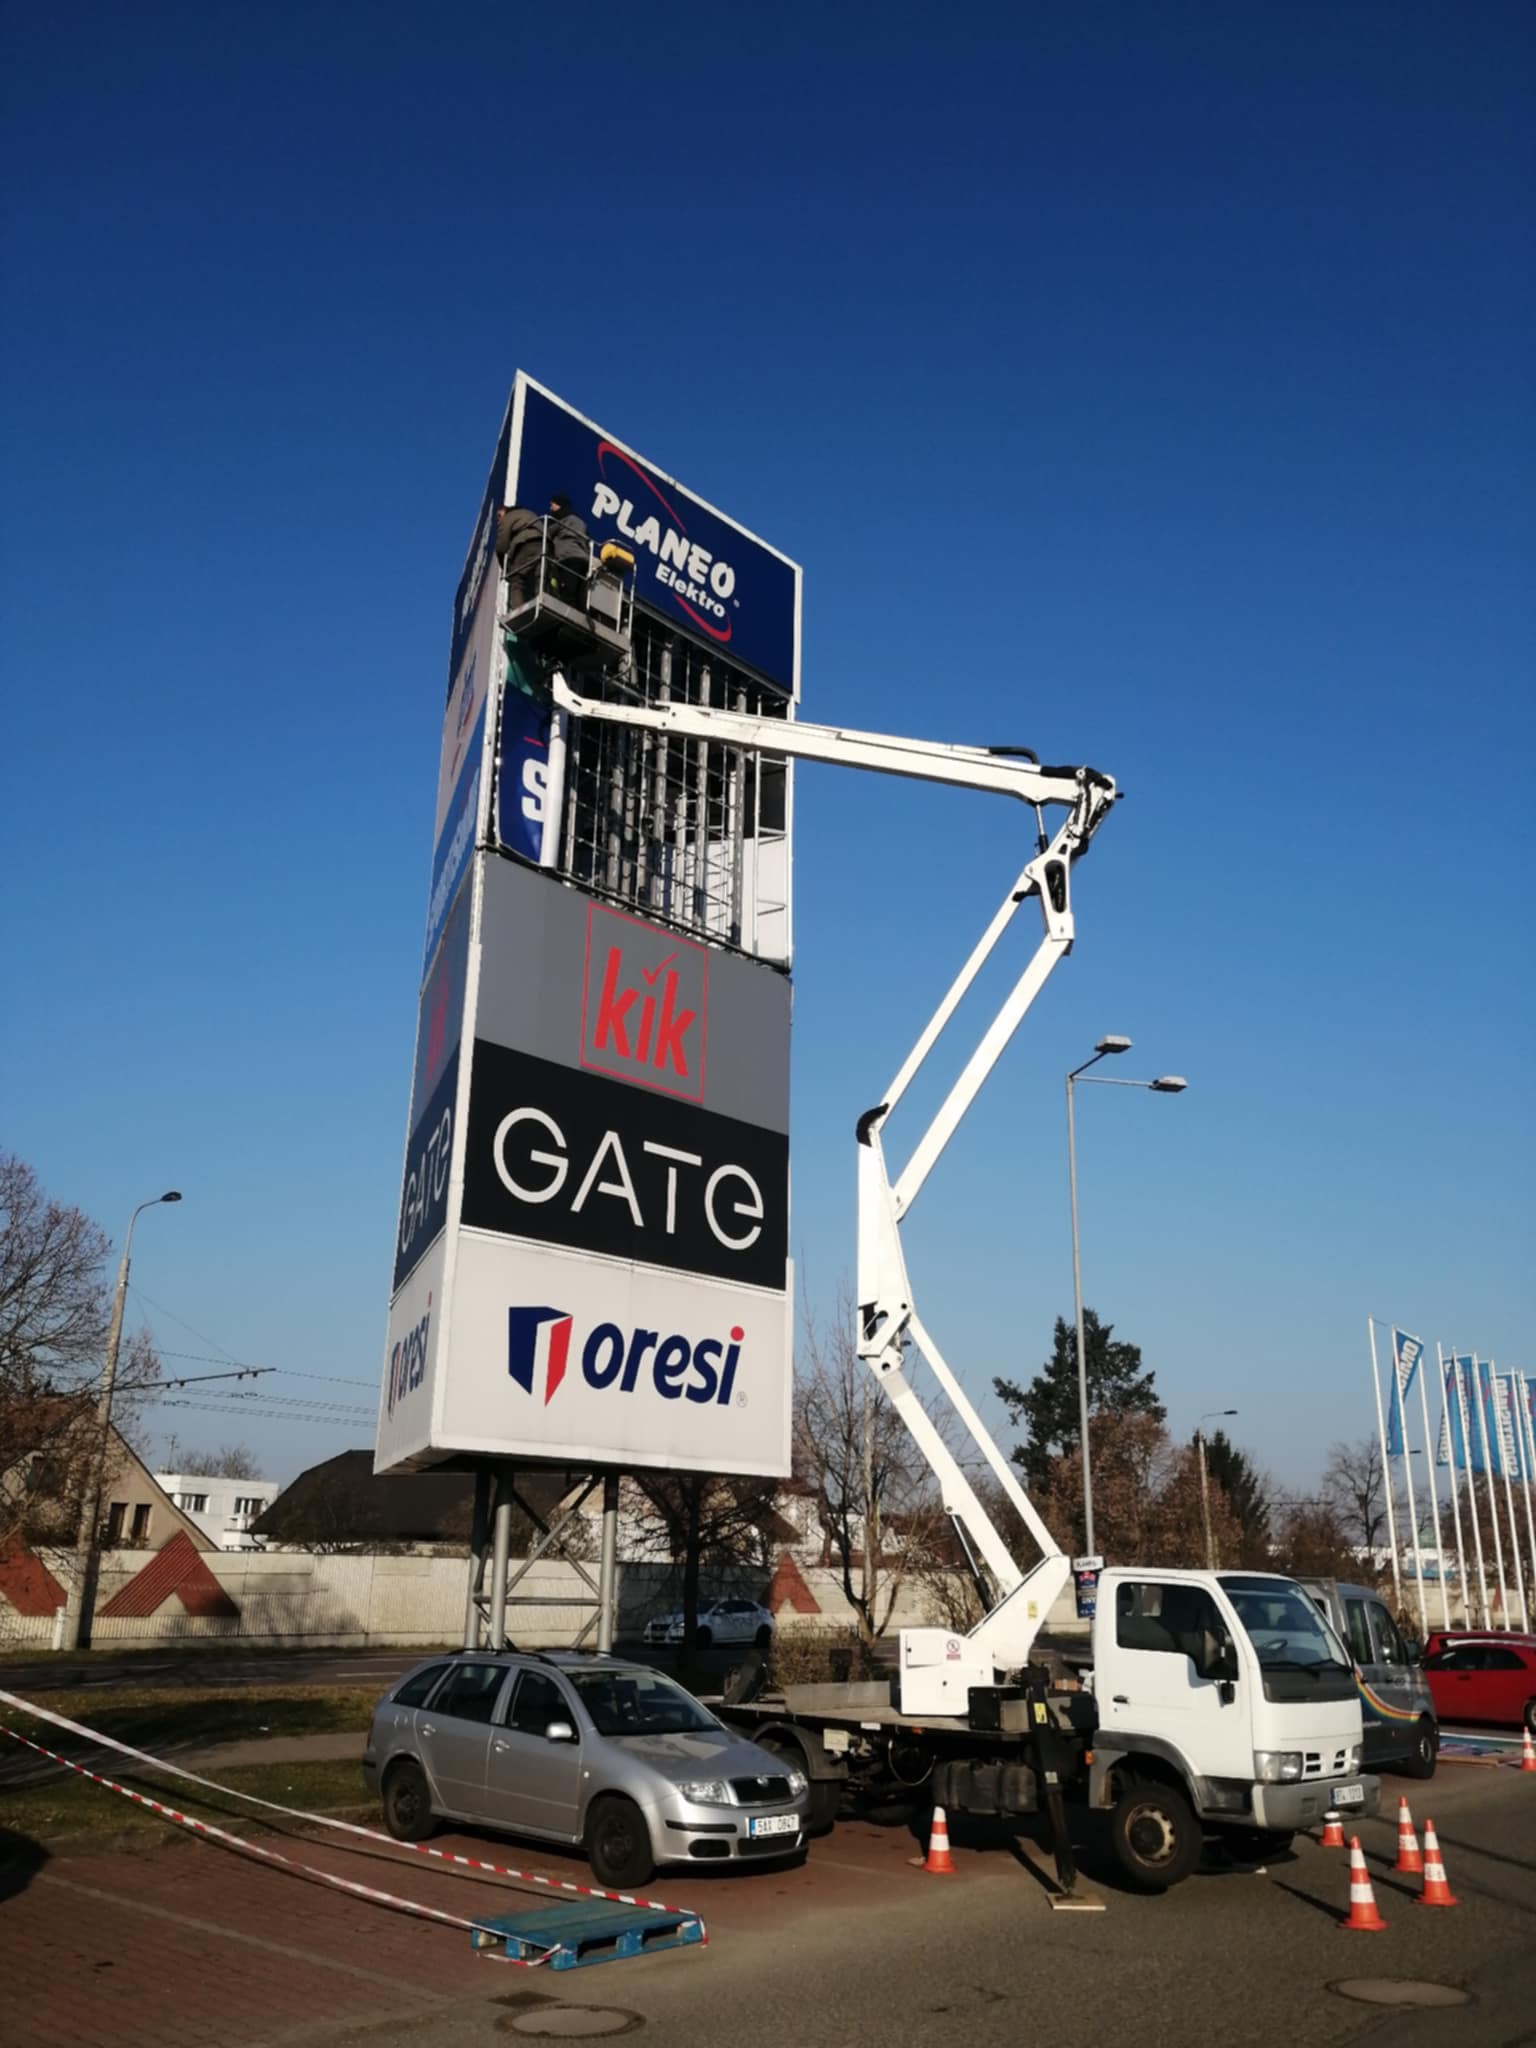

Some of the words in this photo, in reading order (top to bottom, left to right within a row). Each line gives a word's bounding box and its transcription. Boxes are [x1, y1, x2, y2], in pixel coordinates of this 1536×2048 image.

[592, 482, 735, 598] PLANEO
[656, 562, 725, 617] Elektro
[593, 945, 698, 1077] kik
[581, 1322, 745, 1405] oresi
